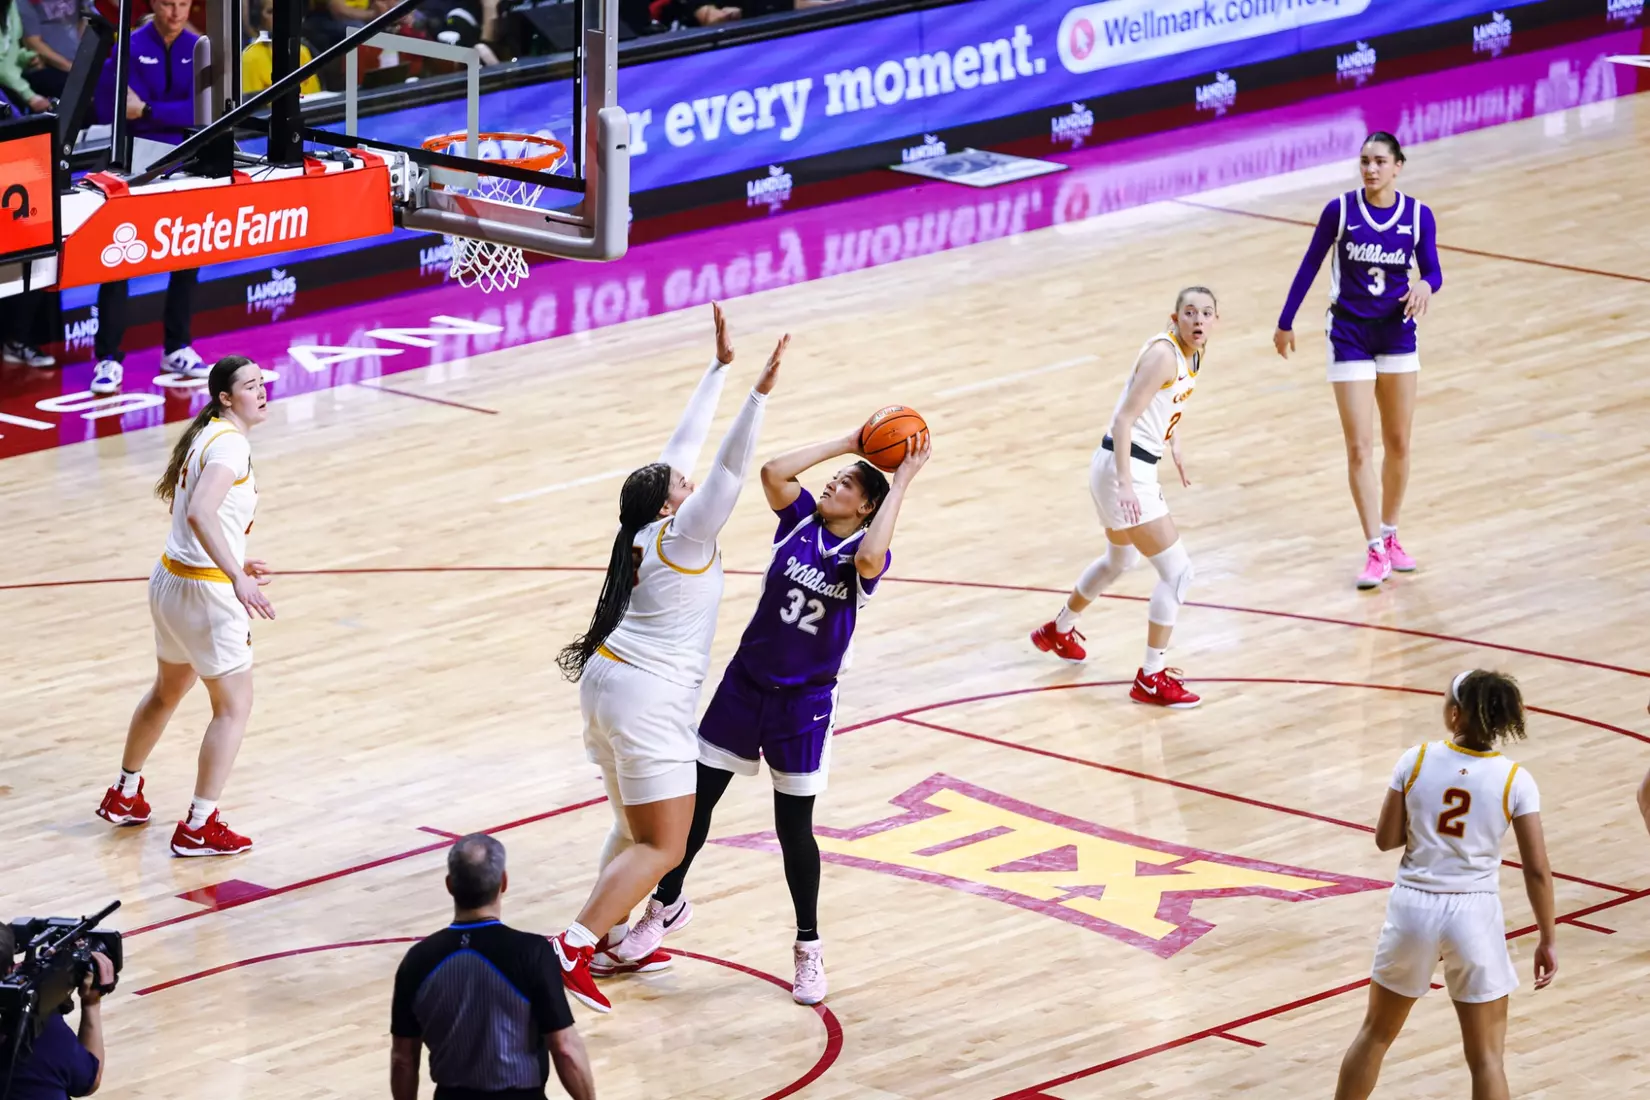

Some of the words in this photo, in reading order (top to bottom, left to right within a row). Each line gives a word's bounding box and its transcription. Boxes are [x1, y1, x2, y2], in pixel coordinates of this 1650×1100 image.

[1104, 0, 1340, 46] Wellmark.com/
[1473, 18, 1512, 42] LANDUS
[1336, 48, 1376, 71] LANDUS
[664, 78, 812, 148] every
[824, 24, 1047, 117] moment.
[1196, 79, 1237, 102] LANDUS
[1052, 110, 1094, 134] LANDUS
[747, 175, 792, 197] LANDUS
[1346, 241, 1406, 265] Wildcats
[246, 277, 297, 303] LANDUS
[1367, 267, 1386, 296] 3
[65, 317, 98, 340] LAND
[783, 556, 849, 601] Wildcats
[779, 587, 826, 636] 32
[1436, 787, 1471, 839] 2
